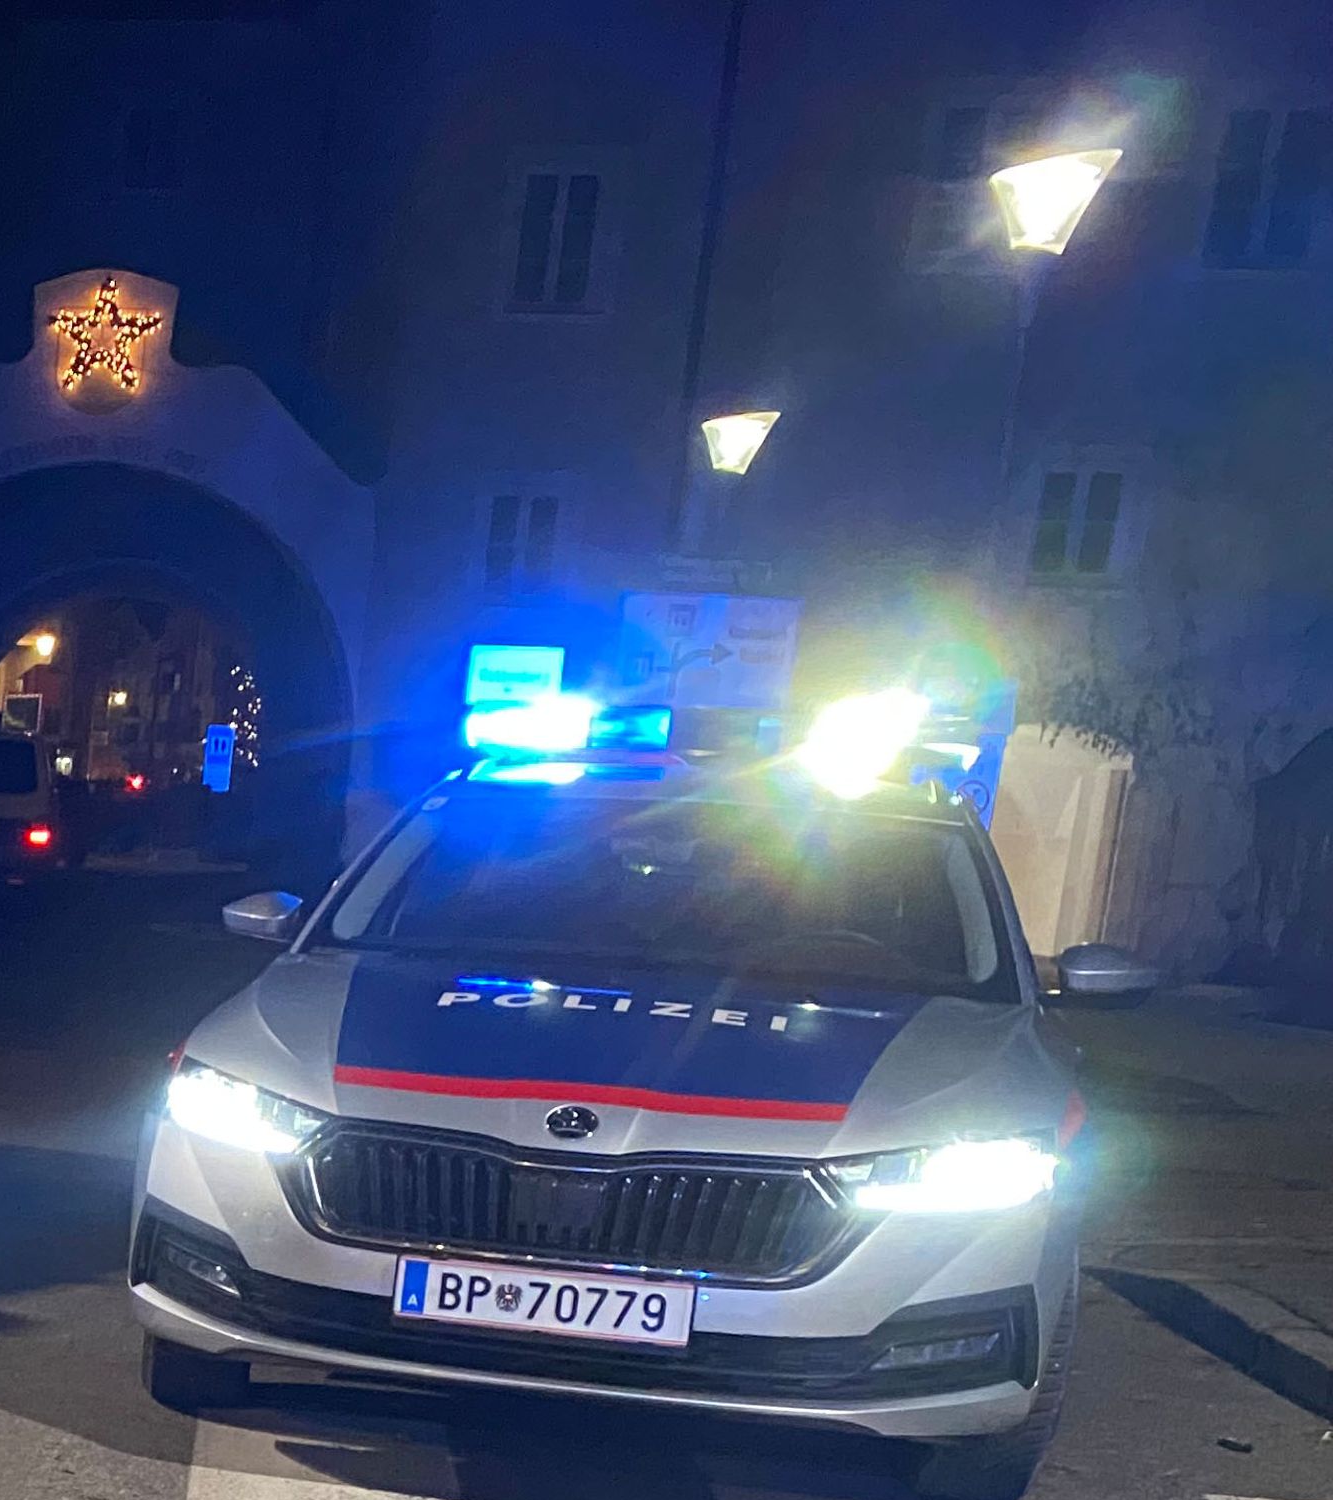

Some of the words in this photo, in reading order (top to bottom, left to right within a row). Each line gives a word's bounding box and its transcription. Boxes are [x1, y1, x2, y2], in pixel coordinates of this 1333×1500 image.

[437, 991, 789, 1032] POLIZEI
[438, 1271, 492, 1314] BP
[526, 1281, 668, 1333] 70779
